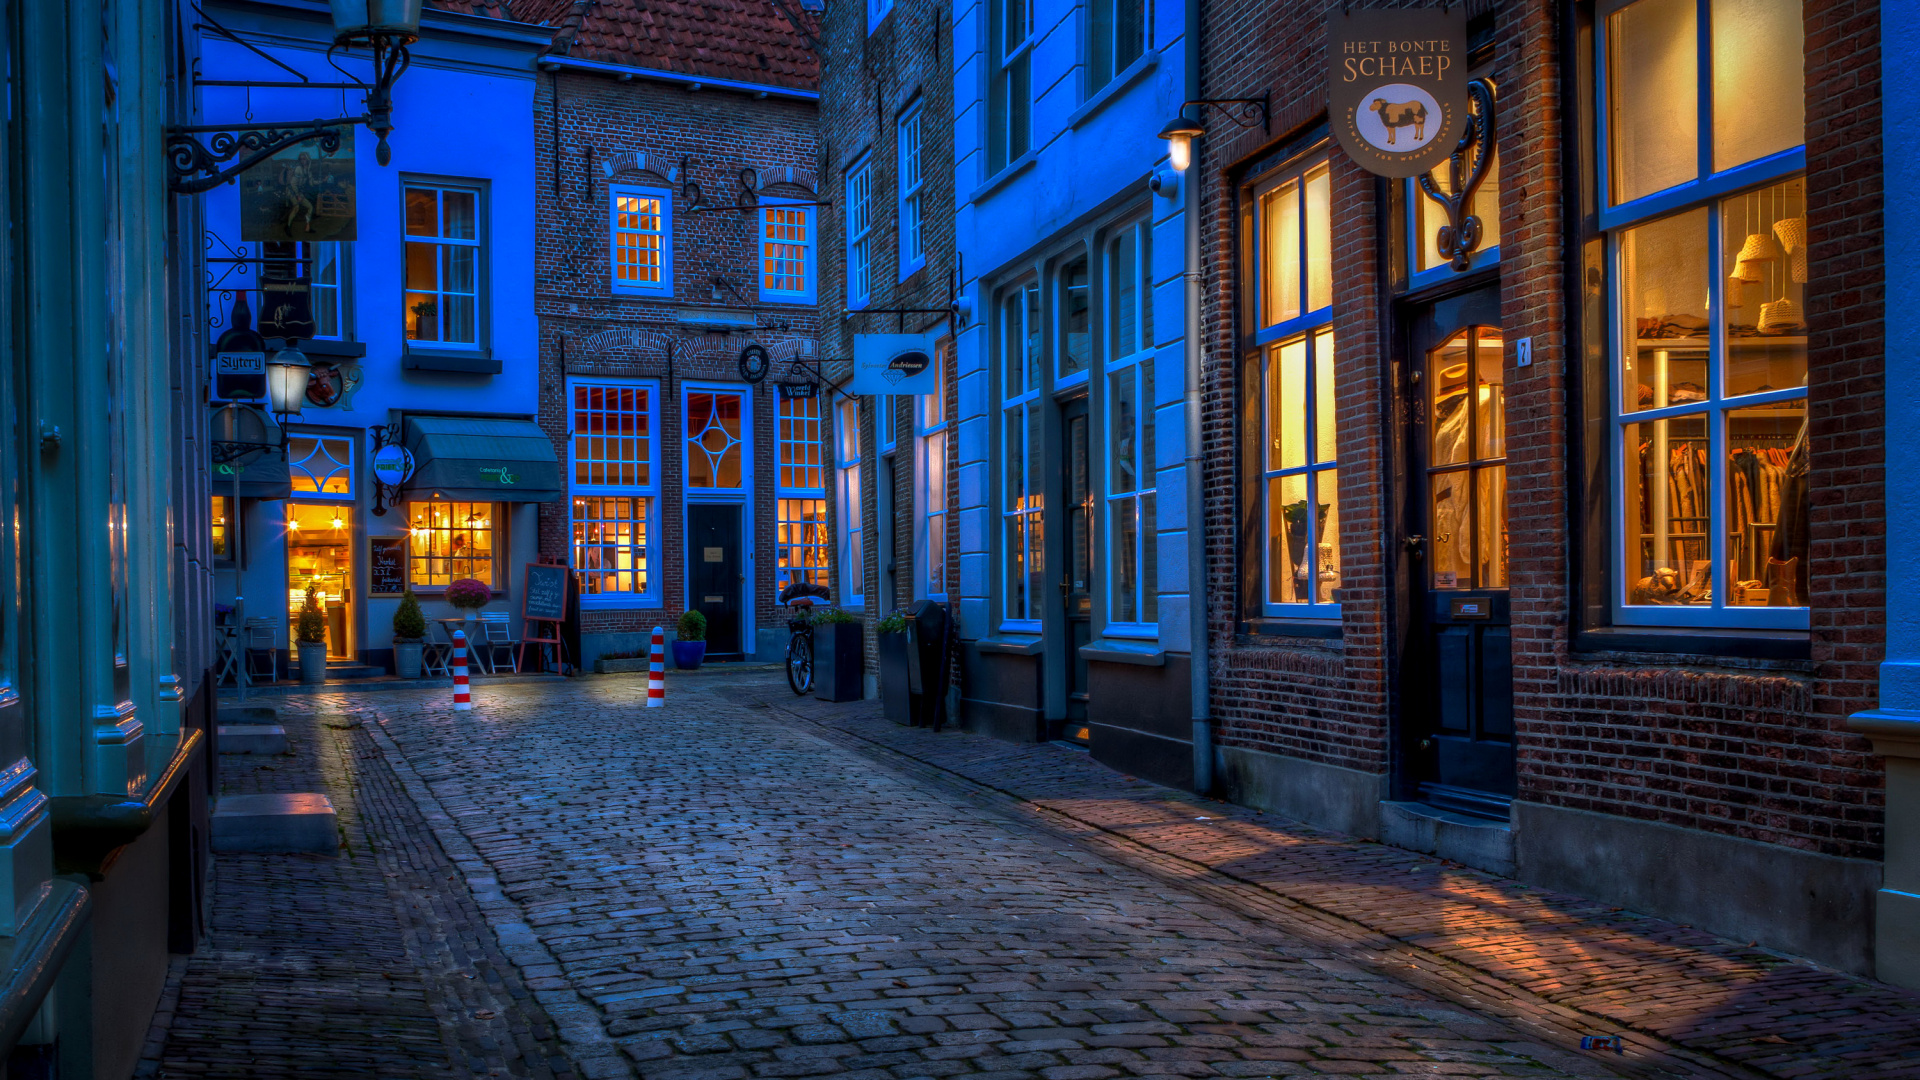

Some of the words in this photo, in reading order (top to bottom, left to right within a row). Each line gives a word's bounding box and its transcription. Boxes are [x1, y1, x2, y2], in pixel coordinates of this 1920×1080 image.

[1343, 41, 1381, 54] HET
[1388, 40, 1451, 53] BONTE
[1343, 55, 1451, 82] SCHAEP
[1347, 107, 1370, 152] KNITWEAR
[1375, 153, 1392, 161] FOR
[1437, 102, 1452, 143] CASUALS
[1520, 342, 1527, 363] 7
[890, 361, 923, 369] Andriessen
[500, 466, 515, 484] &
